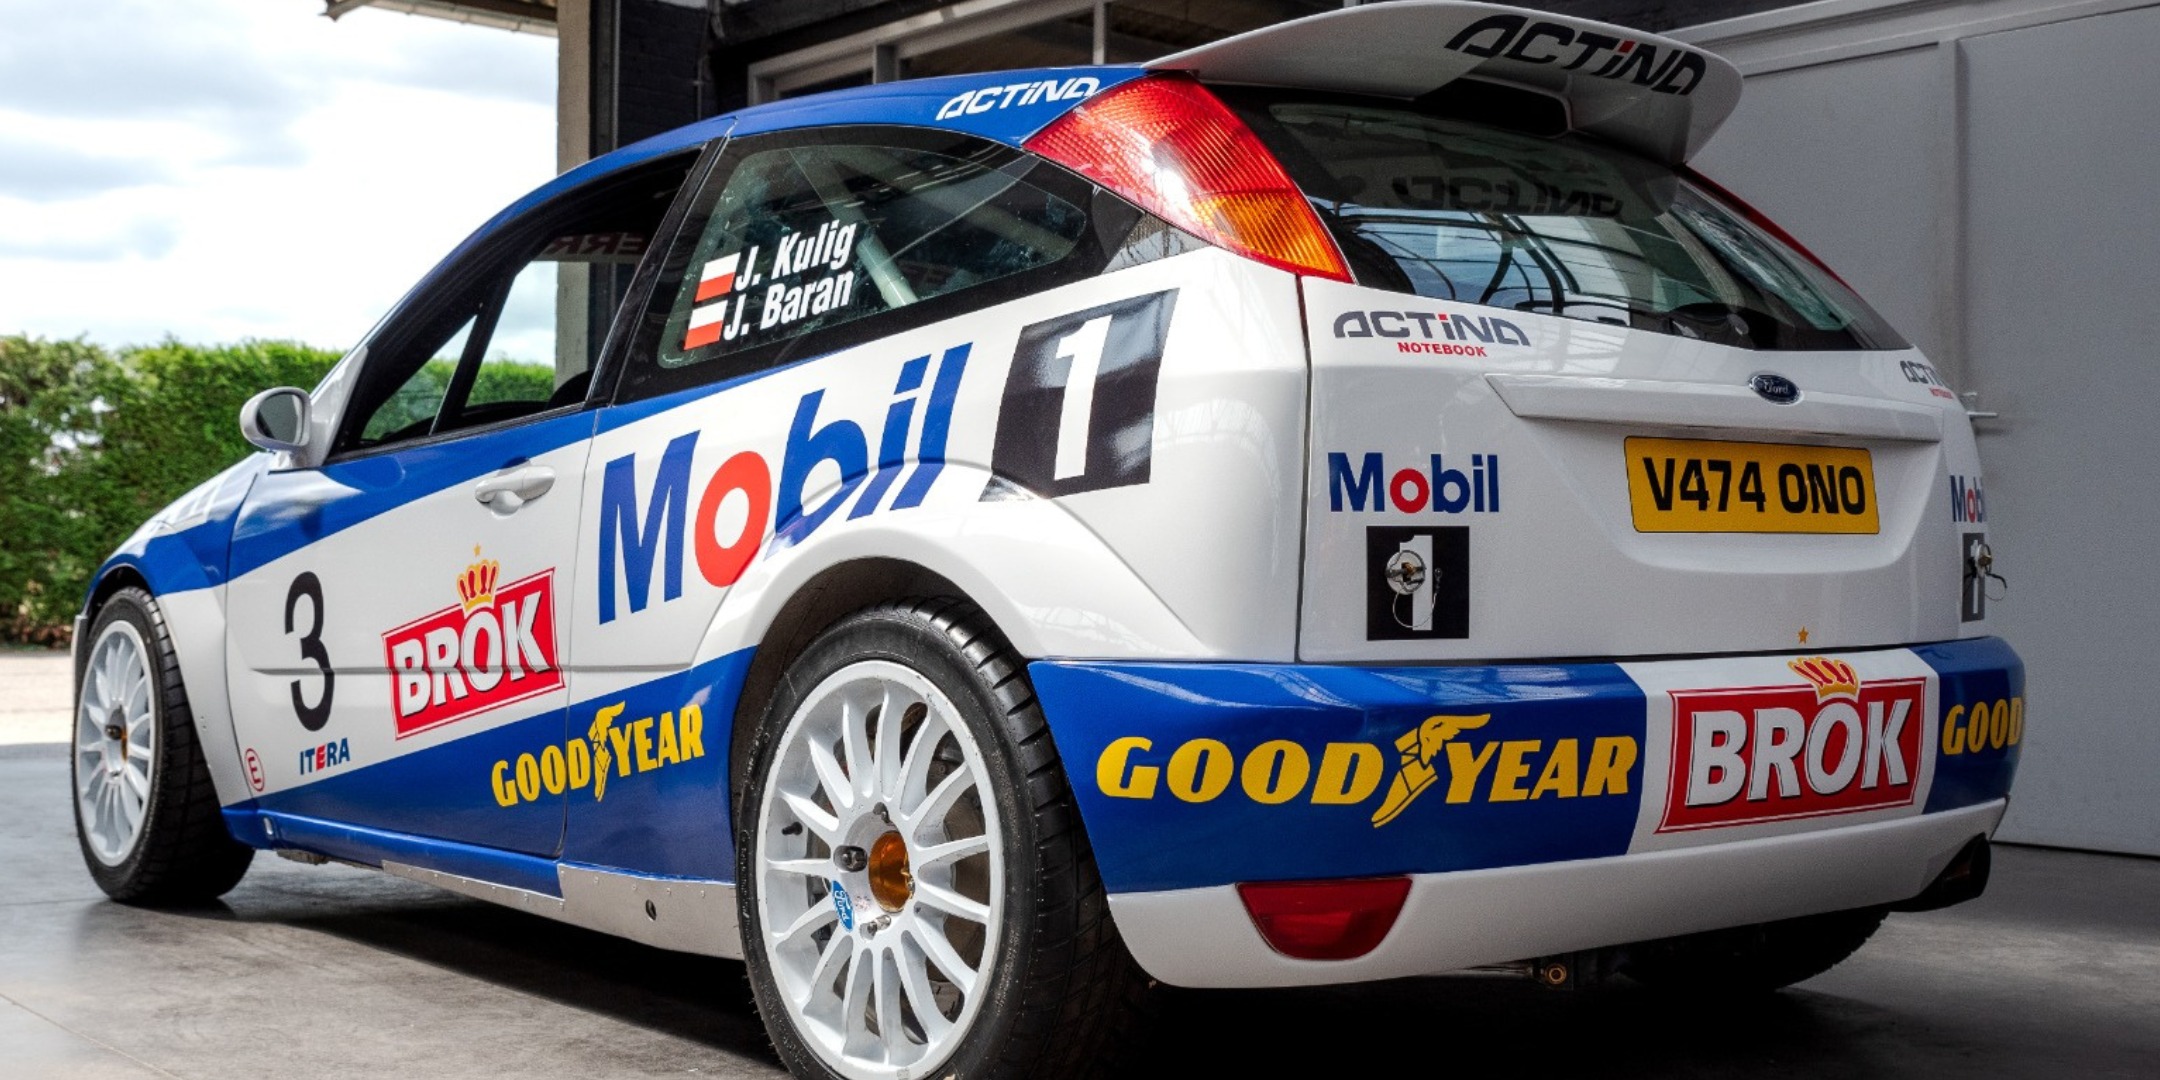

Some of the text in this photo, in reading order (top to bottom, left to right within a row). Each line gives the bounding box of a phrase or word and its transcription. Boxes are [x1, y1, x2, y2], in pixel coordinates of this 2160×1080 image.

[735, 219, 857, 291] J. Kulig
[723, 270, 854, 341] J. Baran
[1397, 341, 1488, 358] NOTEBOOK
[598, 312, 1112, 626] Mobil 1
[1328, 452, 1500, 514] Mobil
[1642, 457, 1866, 515] V474 ONO
[1399, 534, 1434, 631] 1
[284, 571, 335, 732] 3
[392, 590, 548, 718] BROK
[300, 737, 351, 776] ITERA
[1684, 699, 1912, 808] BROK
[834, 890, 851, 922] Ford
